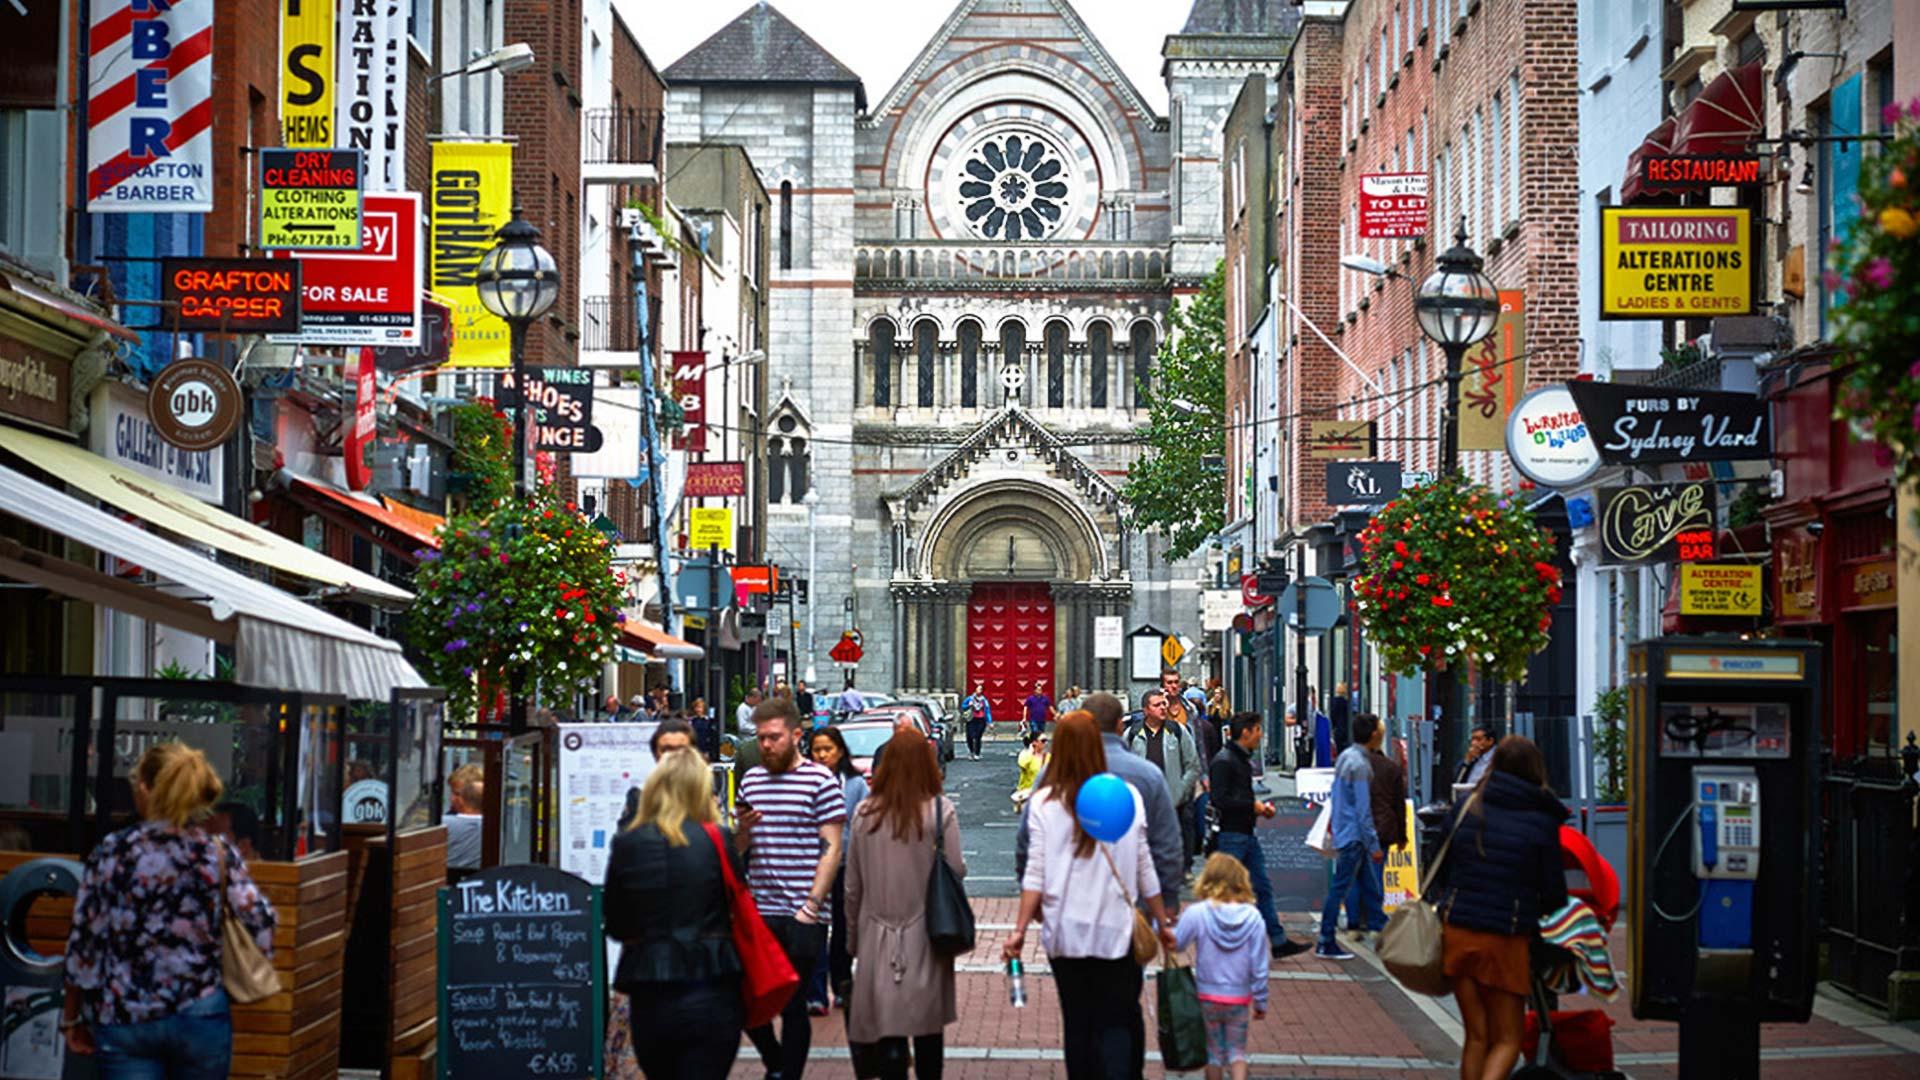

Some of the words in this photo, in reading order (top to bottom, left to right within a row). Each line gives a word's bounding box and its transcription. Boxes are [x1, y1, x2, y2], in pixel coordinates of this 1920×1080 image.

[129, 0, 172, 157] BER
[286, 116, 328, 143] HEMS
[295, 152, 332, 168] DRY
[114, 163, 203, 179] GRAFTON
[265, 168, 355, 186] CLEANING
[1648, 159, 1760, 182] RESTAURANT
[117, 185, 195, 201] BARBER
[274, 190, 346, 204] CLOTHING
[263, 207, 359, 220] ALTERATIONS
[1369, 199, 1393, 209] TO
[1397, 199, 1426, 209] LET
[435, 170, 497, 286] GOTHAM
[1627, 222, 1730, 240] TAILORING
[1618, 251, 1742, 270] ALTERATIONS
[174, 270, 291, 293] GRAFTON
[1643, 273, 1715, 292] CENTRE
[341, 287, 389, 303] SALE
[1617, 297, 1670, 310] LADIES
[1675, 297, 1684, 309] &
[1689, 297, 1742, 310] GENTS
[181, 296, 282, 318] BARBER
[542, 368, 591, 385] WINES
[174, 389, 214, 417] gbk
[674, 364, 704, 438] MBT
[1625, 398, 1670, 413] FURS
[1677, 397, 1700, 411] BY
[536, 426, 585, 447] NGE
[1604, 415, 1696, 459] Sydney
[1701, 413, 1763, 447] Vard
[1603, 484, 1706, 560] Cave
[1679, 545, 1714, 560] BAR
[1691, 569, 1753, 578] ALTERATION
[1702, 579, 1742, 588] CENTRE
[355, 801, 384, 821] gbk
[456, 879, 495, 914] The
[496, 879, 569, 913] Kitchen
[453, 921, 485, 943] Soup
[495, 942, 506, 964] &
